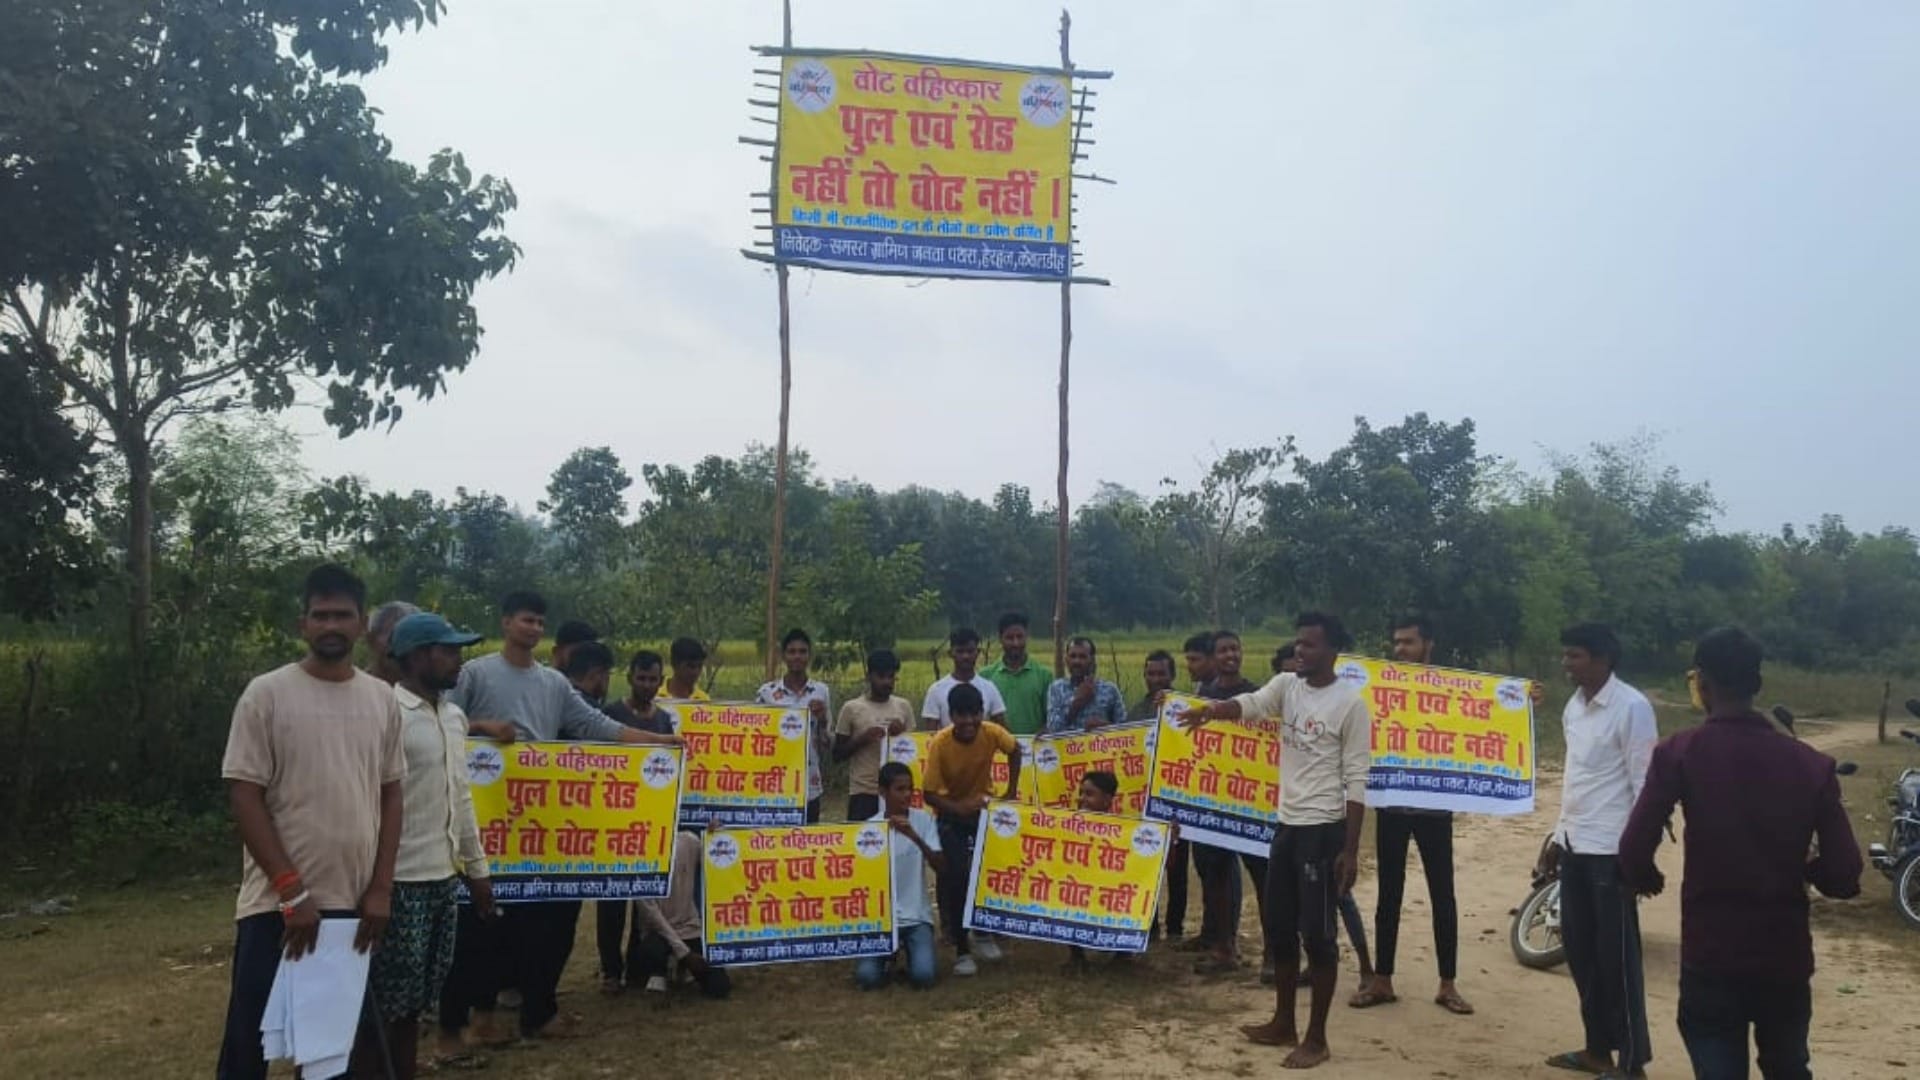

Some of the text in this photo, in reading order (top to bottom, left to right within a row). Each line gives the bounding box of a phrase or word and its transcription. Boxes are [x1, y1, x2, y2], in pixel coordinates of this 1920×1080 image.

[853, 61, 897, 93] वोट
[838, 101, 1018, 156] पुल एवं रोड
[790, 156, 854, 205] नहीं
[860, 160, 899, 209] तो
[908, 164, 967, 213] वोट
[976, 169, 1039, 217] नहीं
[1381, 664, 1409, 682] वोट
[1372, 686, 1410, 719] पुल
[1416, 688, 1453, 716] एवं
[1457, 690, 1494, 720] रोड
[518, 744, 549, 768] वोट
[682, 727, 778, 760] पुल एवं रोड
[1192, 728, 1226, 760] पुल
[1232, 732, 1263, 762] एवं
[1265, 734, 1280, 767] रो
[1386, 720, 1410, 752] तो
[1416, 722, 1458, 754] वोट
[1462, 729, 1509, 762] नहीं
[688, 762, 713, 791] तो
[715, 764, 748, 792] वोट
[752, 765, 788, 794] नहीं
[1122, 750, 1145, 777] रोड
[1160, 758, 1197, 788] नहीं
[1198, 763, 1222, 797] तो
[1226, 768, 1260, 802] वोट
[506, 772, 640, 817] पुल एवं रोड
[480, 818, 514, 856] हीं
[518, 819, 549, 856] तो
[554, 820, 599, 856] वोट
[605, 821, 652, 856] नहीं
[1030, 810, 1056, 829] वोट
[750, 830, 776, 850] वोट
[1020, 834, 1056, 867] पुल
[1062, 836, 1094, 867] एवं
[1097, 839, 1130, 872] रोड
[742, 848, 855, 892] पुल एवं रोड
[712, 892, 752, 926] नहीं
[757, 892, 782, 924] तो
[788, 891, 825, 922] वोट
[830, 886, 870, 920] नहीं
[986, 866, 1026, 897] नहीं
[1029, 870, 1054, 902] तो
[1058, 874, 1094, 908] वोट
[1099, 882, 1139, 915] नहीं
